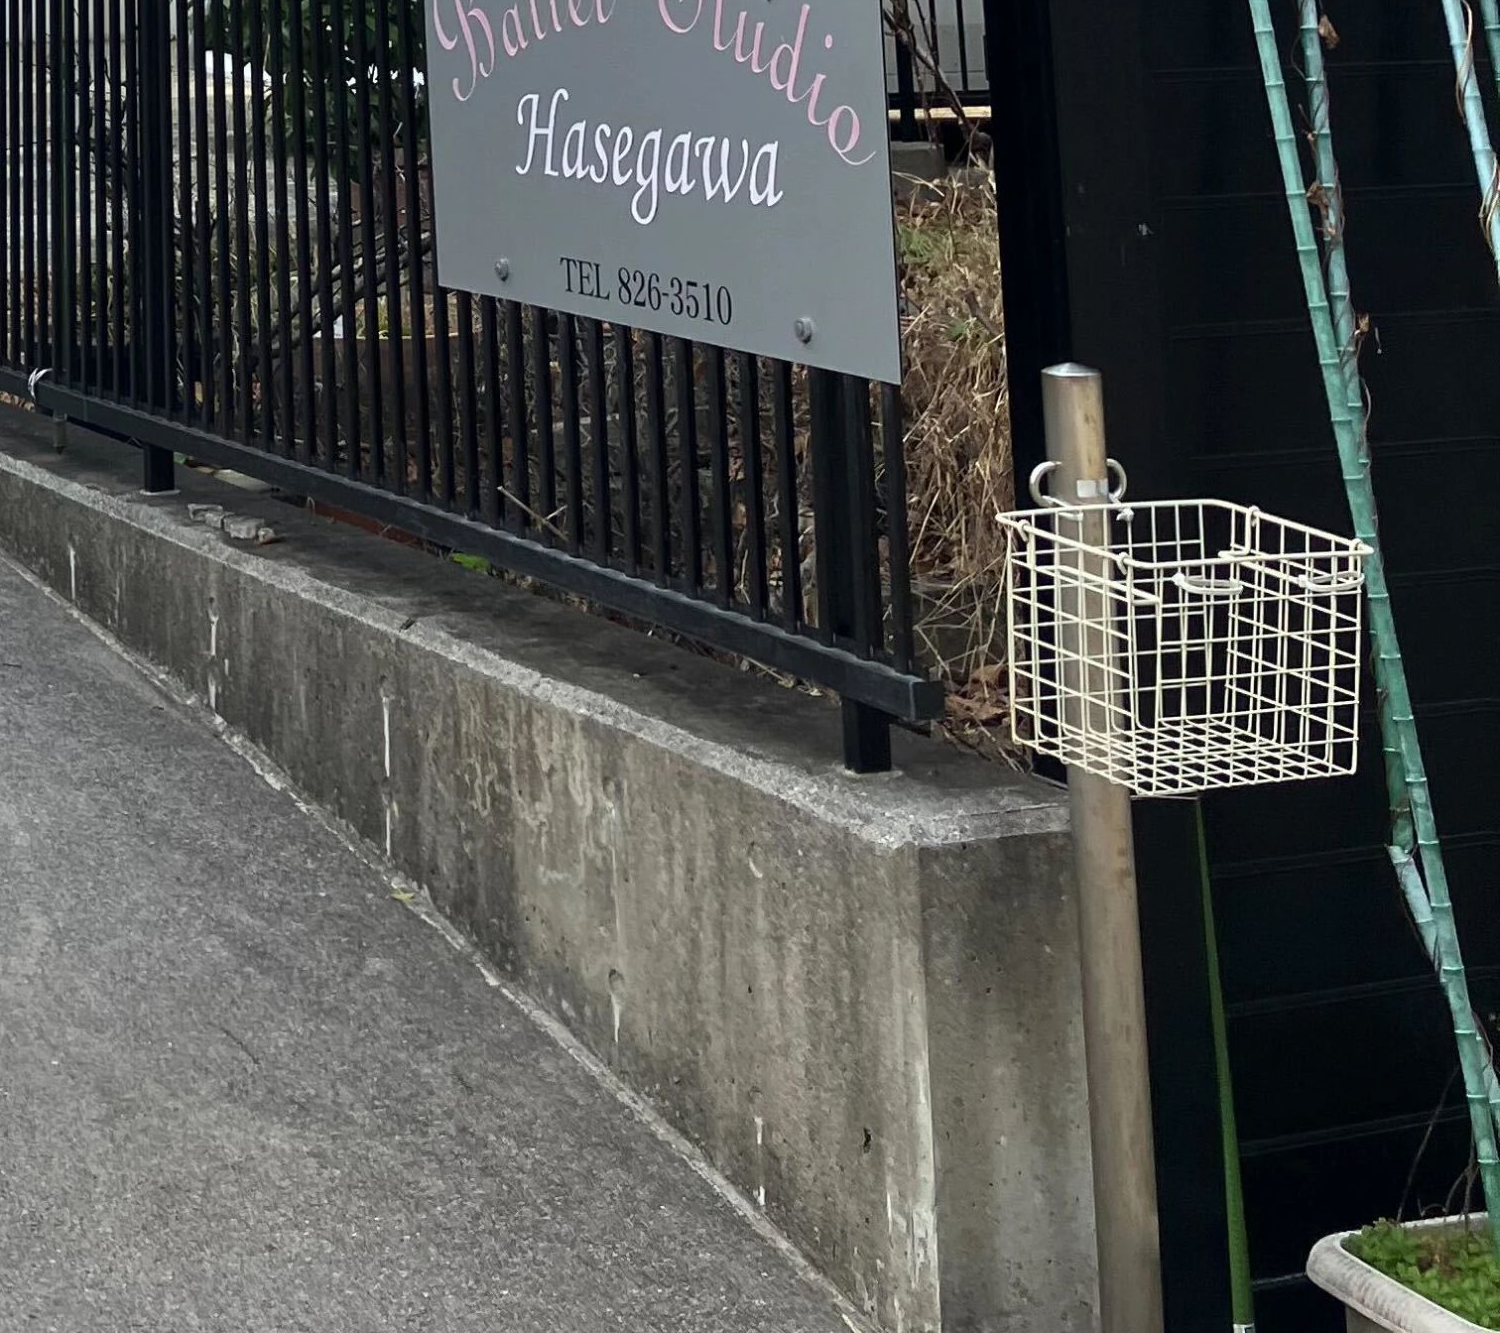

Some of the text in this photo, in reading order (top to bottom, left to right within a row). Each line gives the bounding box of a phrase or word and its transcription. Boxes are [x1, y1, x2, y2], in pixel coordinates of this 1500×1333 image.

[516, 88, 783, 225] Hasegawa
[560, 257, 732, 325] TEL 826-3510
